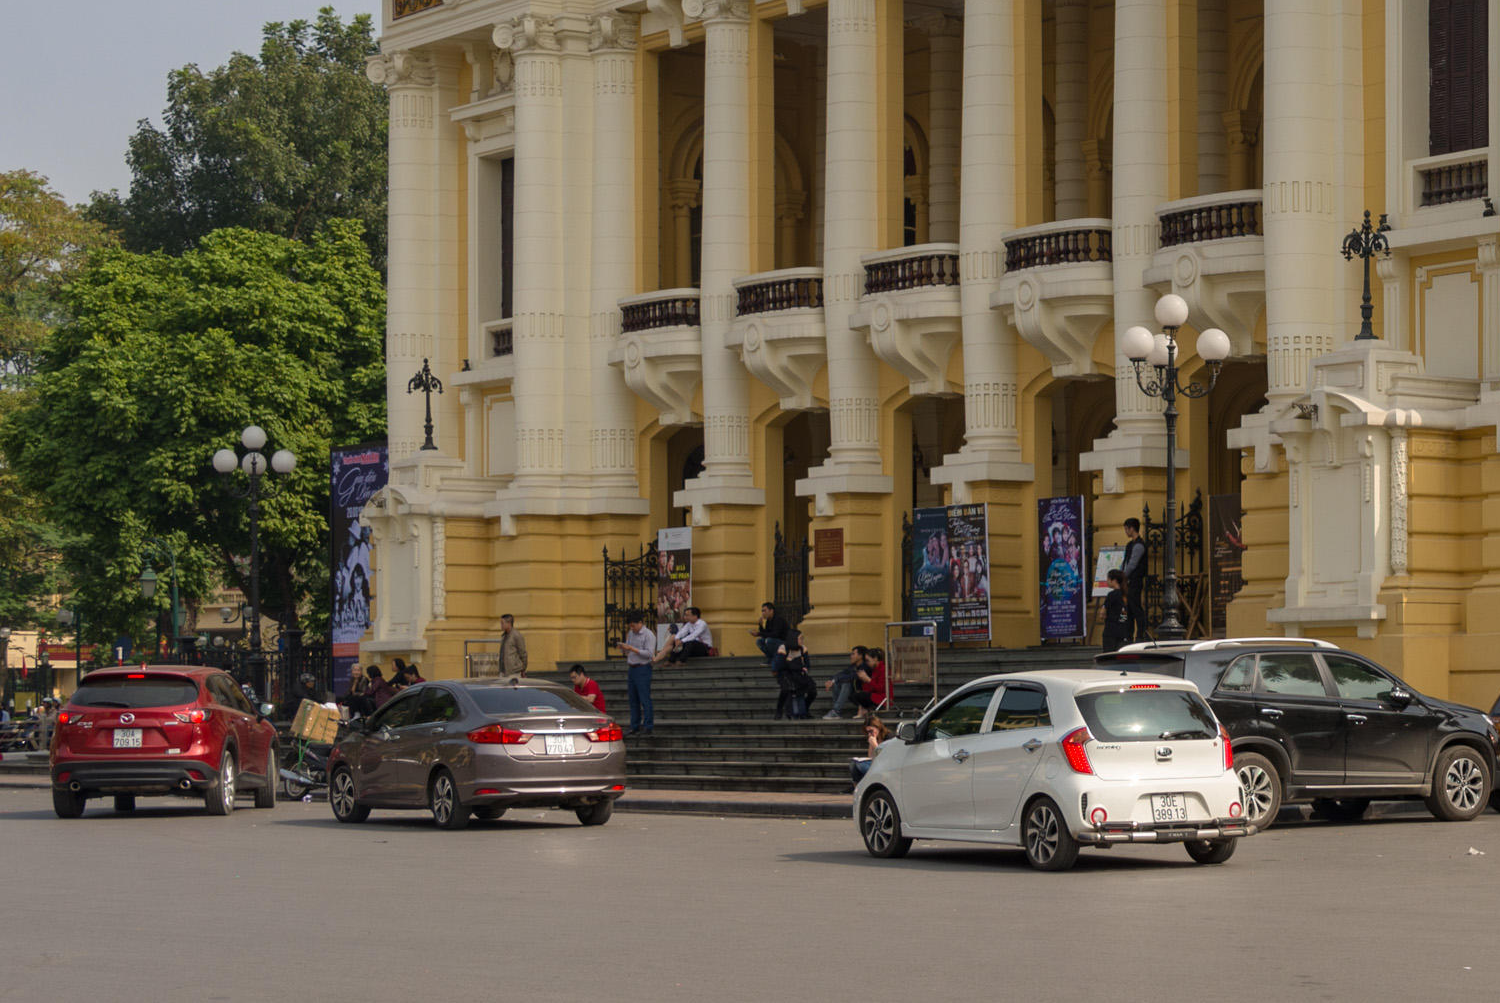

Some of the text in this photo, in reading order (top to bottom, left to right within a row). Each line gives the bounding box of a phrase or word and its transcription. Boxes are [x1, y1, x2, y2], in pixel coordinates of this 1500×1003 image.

[121, 729, 136, 738] 30A
[1160, 795, 1178, 808] 30E
[1155, 808, 1186, 821] 389.13
